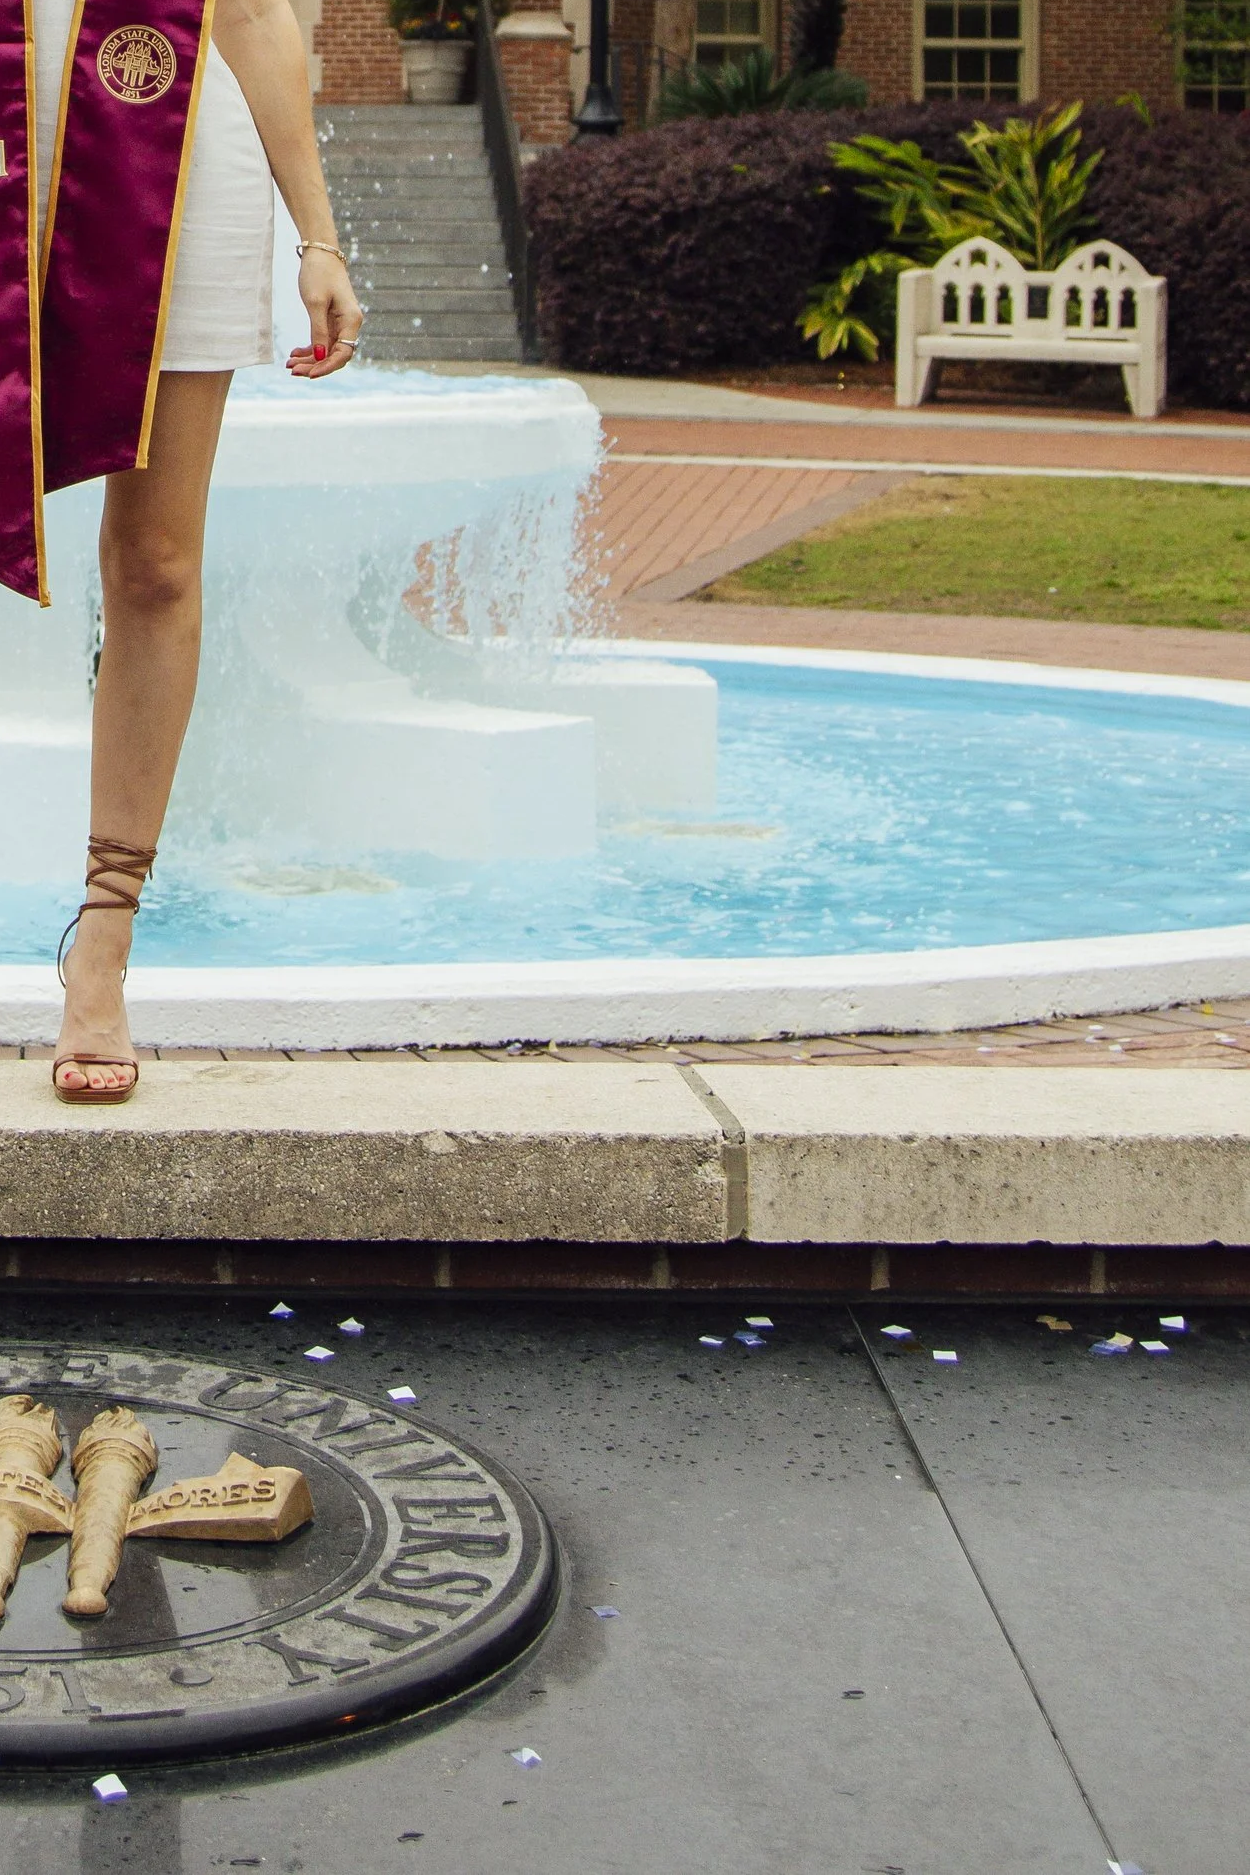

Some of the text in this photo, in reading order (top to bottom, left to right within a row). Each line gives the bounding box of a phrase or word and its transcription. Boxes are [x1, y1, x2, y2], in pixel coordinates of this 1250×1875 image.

[102, 30, 171, 91] FLORIDA STATE UNIVERSITY
[121, 88, 141, 99] 1851
[128, 1477, 276, 1523] MORES
[198, 1372, 511, 1686] UNIVERSITY
